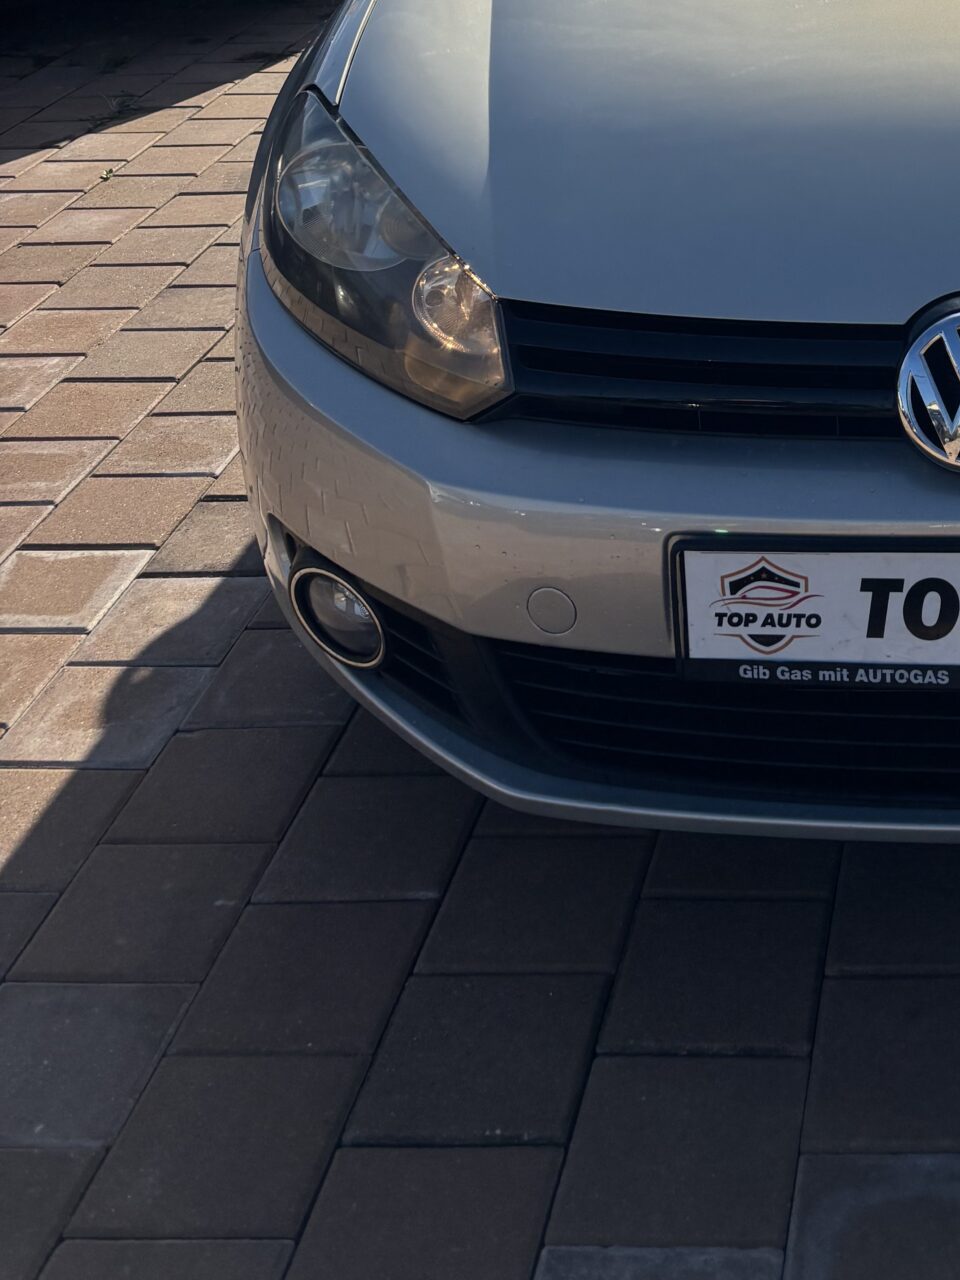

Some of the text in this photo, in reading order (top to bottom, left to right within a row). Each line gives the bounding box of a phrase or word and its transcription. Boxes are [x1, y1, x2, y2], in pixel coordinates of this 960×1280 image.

[714, 612, 822, 629] TOP AUTO
[738, 664, 770, 680] Gib
[776, 666, 812, 681] Gas
[818, 667, 850, 682] mit
[855, 669, 950, 685] AUTOGAS
